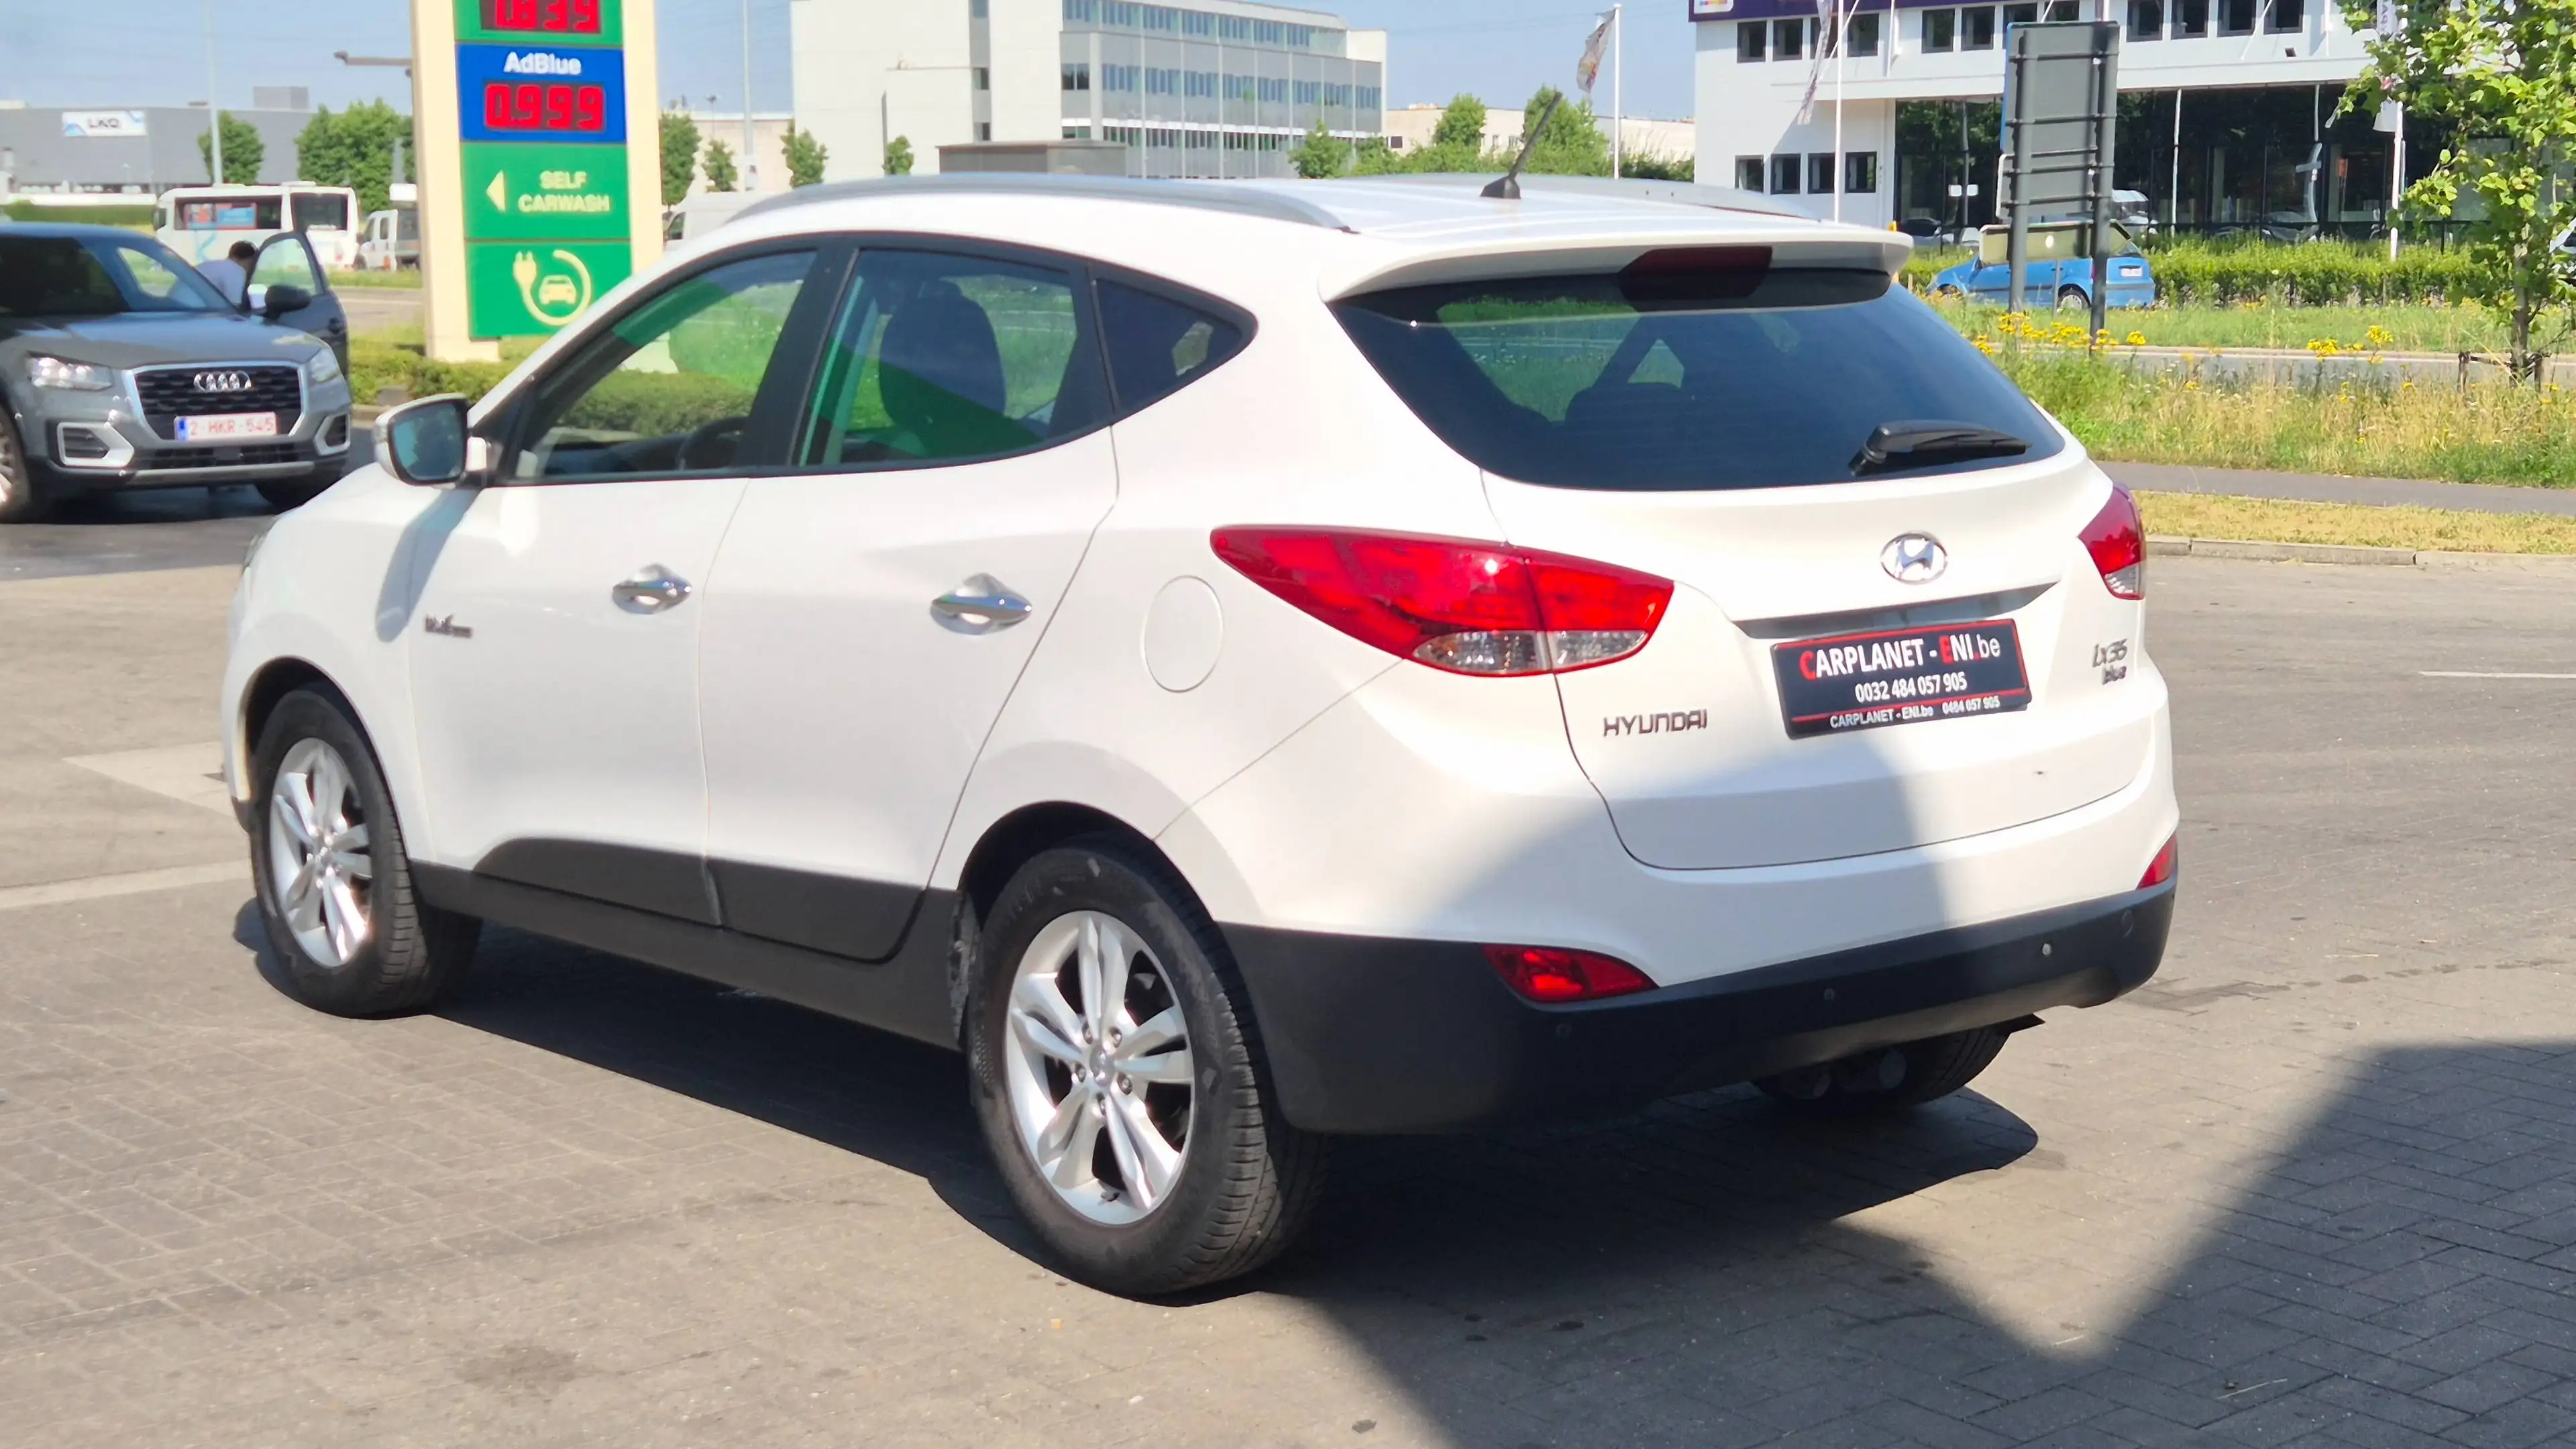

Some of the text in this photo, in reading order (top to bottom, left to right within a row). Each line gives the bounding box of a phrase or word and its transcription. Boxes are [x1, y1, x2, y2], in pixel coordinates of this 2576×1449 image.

[503, 51, 582, 75] AdBlue
[539, 170, 586, 189] SELF
[518, 193, 610, 212] CARWASH
[1799, 639, 1924, 680] CARPLANET
[1939, 633, 2000, 664] ENI.be
[1855, 671, 1968, 703] 0032 484 057 905
[1603, 709, 1708, 737] HYUNDAI
[1829, 708, 1894, 729] CARPLANET
[1942, 700, 1965, 714] 0484
[1966, 697, 1982, 712] 057
[1983, 695, 2000, 709] 905
